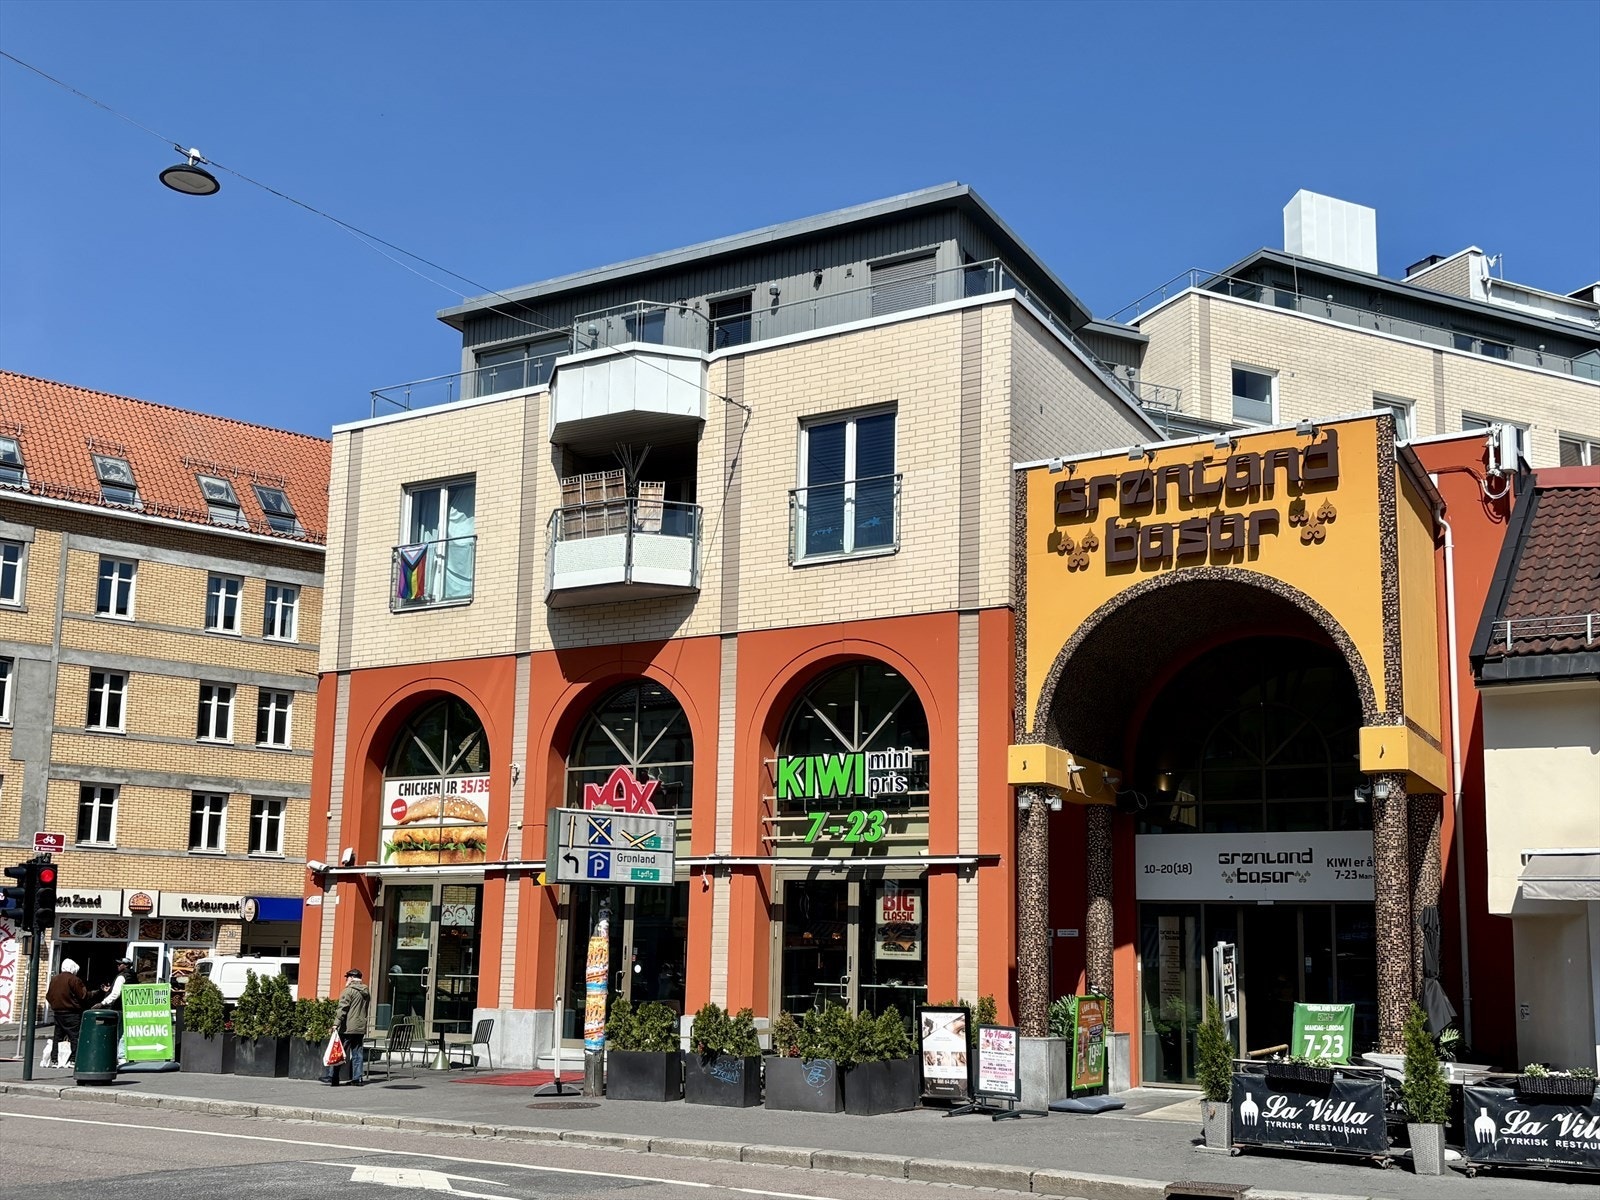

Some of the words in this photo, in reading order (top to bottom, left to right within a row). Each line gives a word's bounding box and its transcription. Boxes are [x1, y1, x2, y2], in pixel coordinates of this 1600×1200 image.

[1105, 509, 1279, 573] basar
[777, 752, 866, 800] KIWI
[869, 746, 912, 770] mini
[398, 781, 440, 797] CHICKEN
[446, 780, 458, 794] JR
[460, 779, 490, 794] 35/39
[584, 765, 659, 815] MAX
[869, 771, 908, 799] pris
[804, 810, 887, 843] 7-23
[1144, 862, 1193, 876] 10-20(18)
[1326, 858, 1352, 868] KIWI
[1354, 859, 1365, 868] er
[1236, 867, 1295, 884] basar
[1335, 870, 1357, 880] 7-23
[56, 896, 71, 907] en
[72, 894, 102, 907] Zaad
[181, 897, 241, 911] Restaurant
[882, 889, 915, 912] BIG
[883, 911, 915, 922] CLASSIC
[123, 988, 154, 1006] KIWI
[154, 998, 168, 1006] pris
[126, 1024, 169, 1037] INNGANG
[1303, 1034, 1344, 1058] 7-23
[1261, 1094, 1304, 1120] La
[1305, 1098, 1374, 1125] Villa
[1265, 1120, 1303, 1130] TYRKISK
[1308, 1123, 1368, 1135] RESTAURANT
[1500, 1110, 1549, 1136] La
[1551, 1112, 1600, 1140] Vil
[1503, 1137, 1549, 1147] TYRKISK
